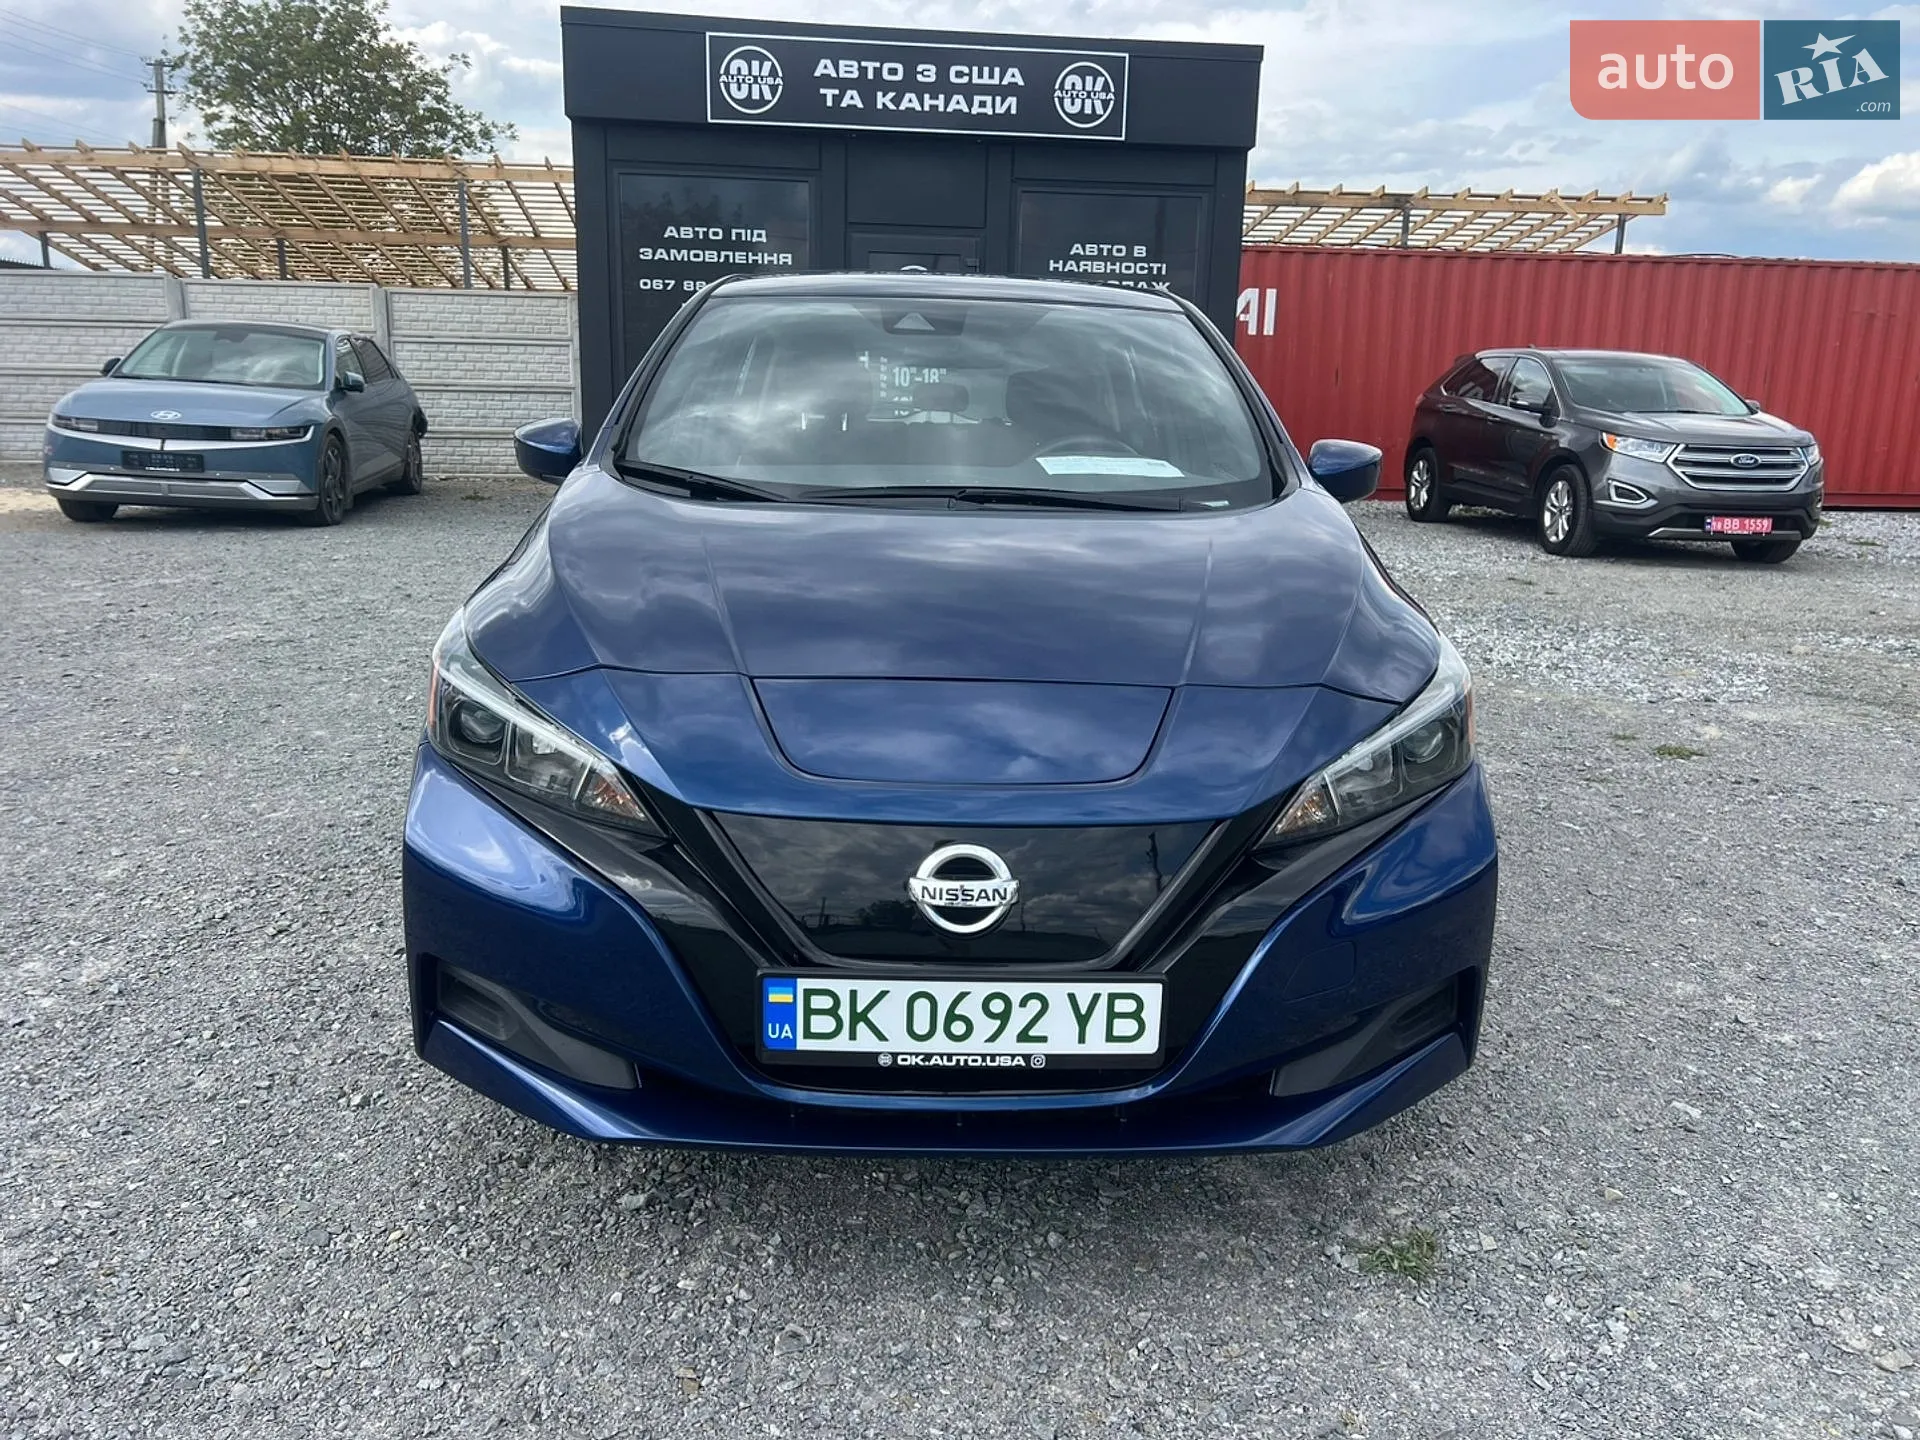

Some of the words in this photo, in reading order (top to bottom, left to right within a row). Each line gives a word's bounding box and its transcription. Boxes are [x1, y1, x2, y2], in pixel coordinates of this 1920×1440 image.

[813, 58, 905, 82] АВТО
[915, 63, 937, 83] З
[949, 65, 1025, 86] США
[719, 75, 754, 84] AUTO
[757, 76, 784, 86] USA
[819, 88, 864, 109] ТА
[876, 91, 1018, 115] КАНАДИ
[1054, 90, 1087, 99] AUTO
[1091, 91, 1115, 101] USA
[663, 226, 724, 241] АВТО
[731, 229, 767, 243] ПІД
[639, 247, 793, 265] ЗАМОВЛЕННЯ
[1069, 243, 1127, 257] АВТО
[1133, 245, 1147, 258] В
[1049, 259, 1167, 275] НАЯВНОСТІ
[639, 278, 676, 291] 067
[921, 885, 1008, 902] NISSAN
[803, 988, 891, 1041] BK
[906, 990, 1049, 1043] 0692
[1066, 992, 1146, 1044] YB
[768, 1023, 793, 1039] UA
[897, 1054, 1026, 1067] OK.AUTO.USA
